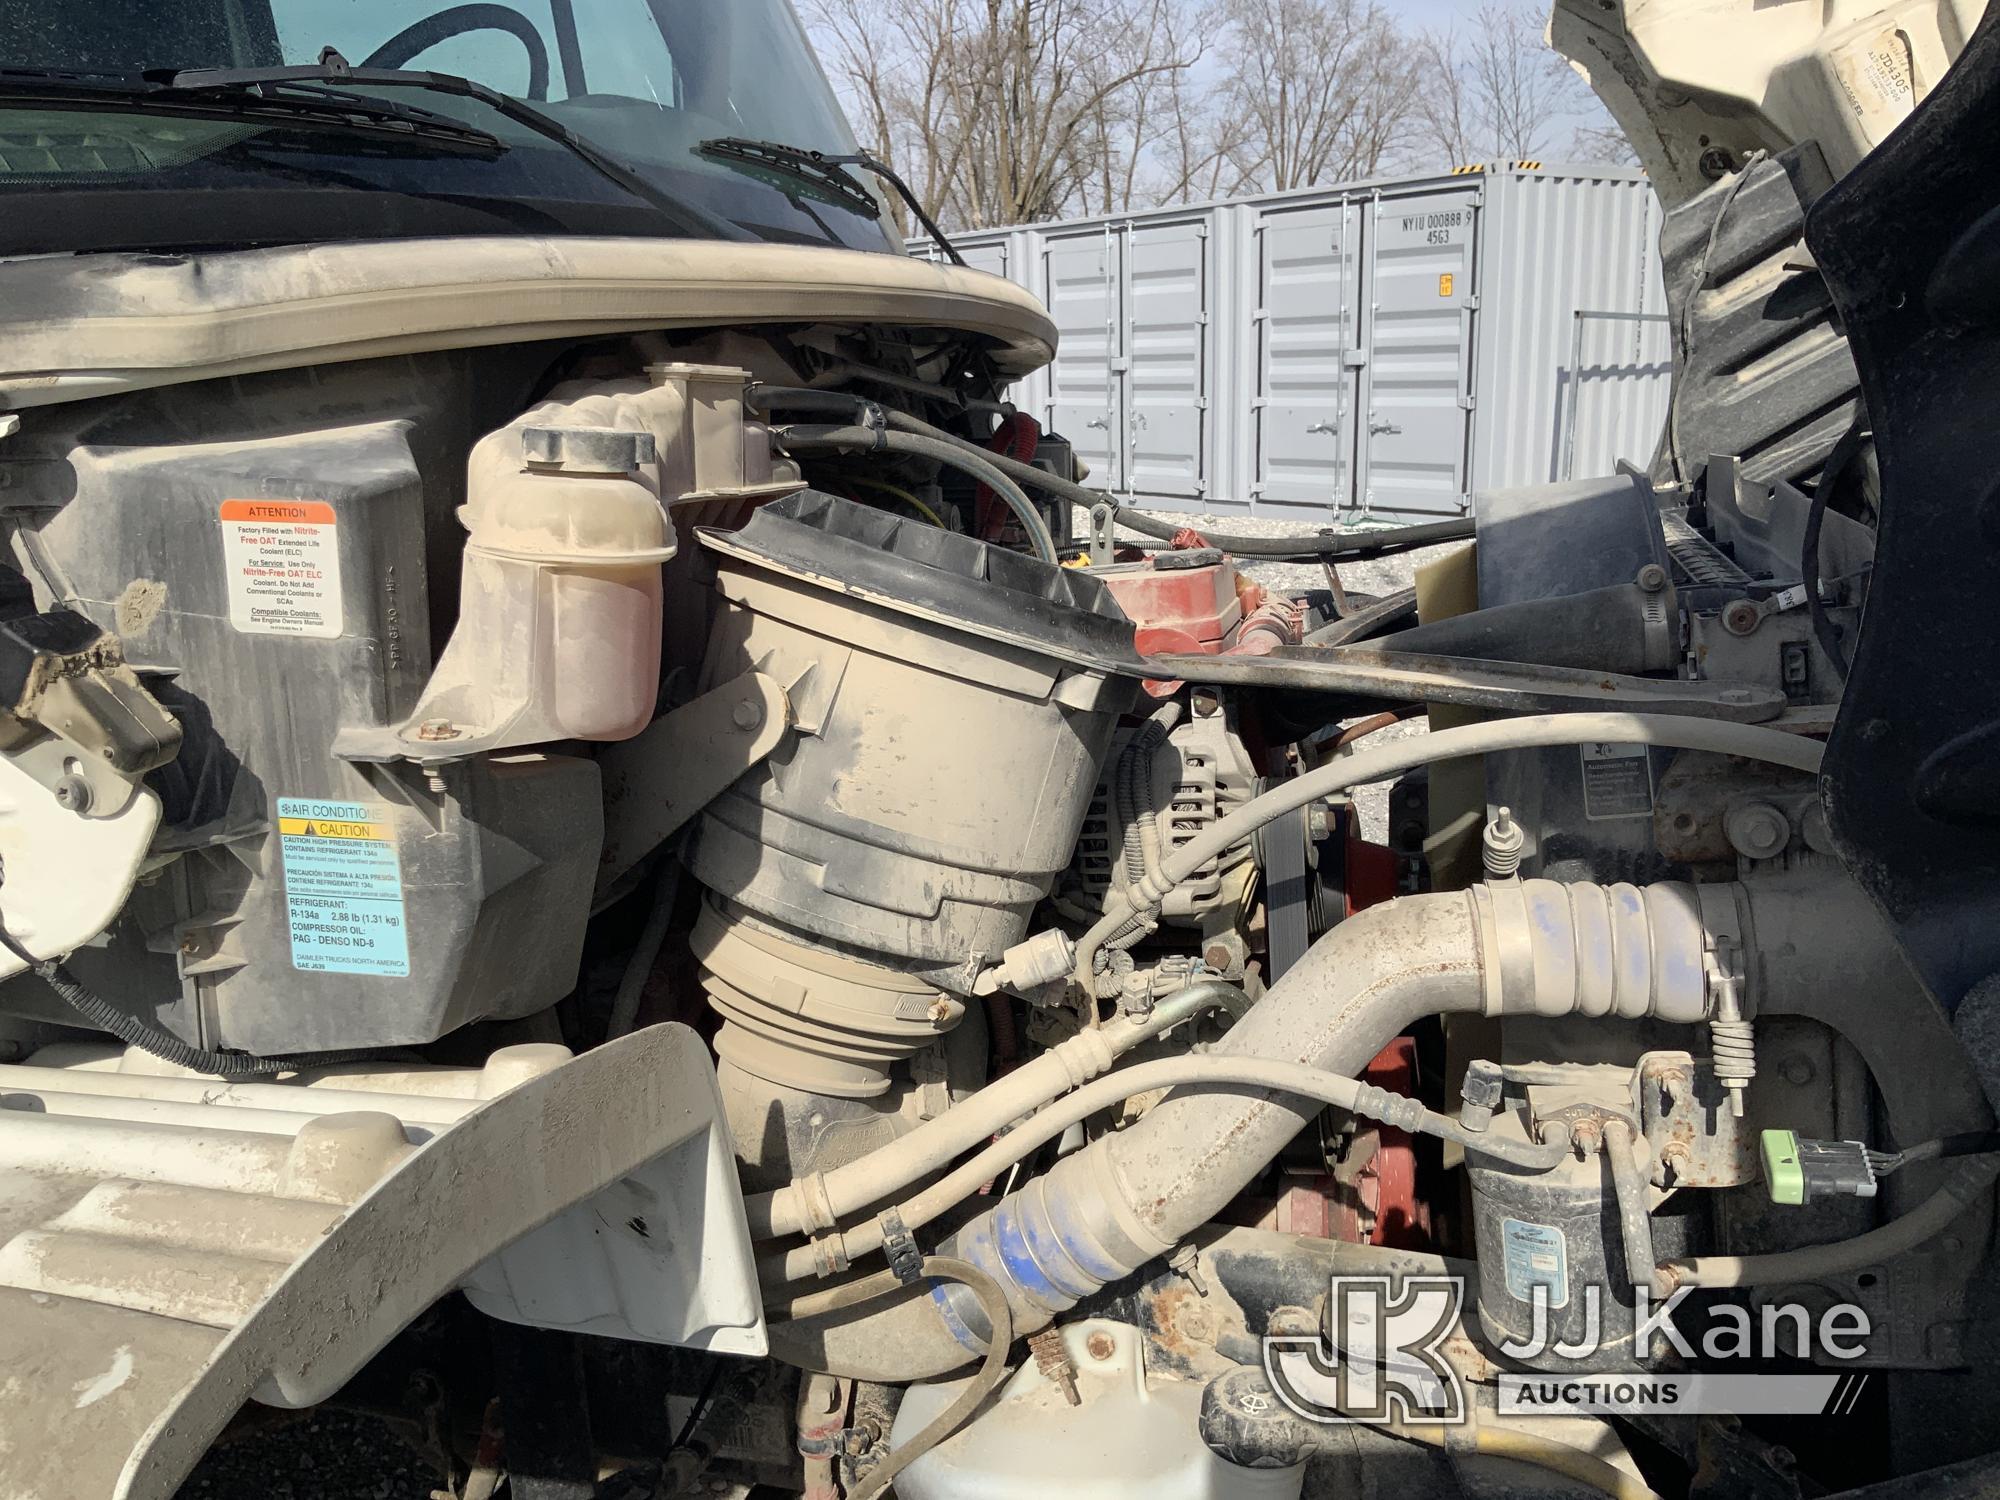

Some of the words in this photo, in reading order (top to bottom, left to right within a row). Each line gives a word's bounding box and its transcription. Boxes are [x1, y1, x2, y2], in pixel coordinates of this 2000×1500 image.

[1880, 53, 1910, 94] JD4305
[1402, 216, 1425, 232] NYIU
[1427, 212, 1462, 229] 000888
[1466, 210, 1472, 226] 9
[1427, 229, 1450, 245] 45G3
[249, 507, 306, 517] ATTENTION
[238, 526, 261, 535] Factory
[262, 527, 279, 535] Filled
[294, 526, 320, 536] Nitrite-
[240, 536, 258, 544] Free
[260, 537, 276, 545] OAT
[278, 539, 307, 547] Extended
[285, 549, 302, 557] (ELC)
[301, 561, 315, 569] Only
[243, 568, 285, 577] Nitrite-Free
[287, 570, 304, 578] OAT
[306, 571, 322, 579] ELC
[246, 588, 287, 596] Conventional
[287, 589, 315, 597] Coolants
[276, 597, 293, 605] SCAs
[251, 608, 288, 616] Compatible
[290, 610, 322, 618] Coolants:
[262, 617, 281, 625] Engine
[291, 804, 309, 815] AIR
[320, 823, 370, 836] CAUTION
[283, 836, 311, 844] CAUTION
[329, 839, 363, 848] PRESSURE
[284, 844, 315, 852] CONTAINS
[317, 846, 361, 855] REFRIGERANT
[287, 877, 315, 885] CONTIENE
[316, 879, 360, 888] REFRIGERANTE
[290, 898, 348, 909] REFRIGERANT:
[291, 909, 319, 919] R-134a
[331, 912, 350, 922] 2.88
[351, 913, 360, 922] lb
[362, 914, 382, 925] (1.31
[385, 916, 400, 926] kg)
[292, 922, 348, 933] COMPRESSOR
[350, 926, 366, 934] OIL:
[293, 934, 310, 944] PAG
[318, 935, 351, 946] DENSO
[353, 938, 375, 947] ND-8
[325, 955, 351, 963] TRUCKS
[376, 959, 405, 967] AMERICA
